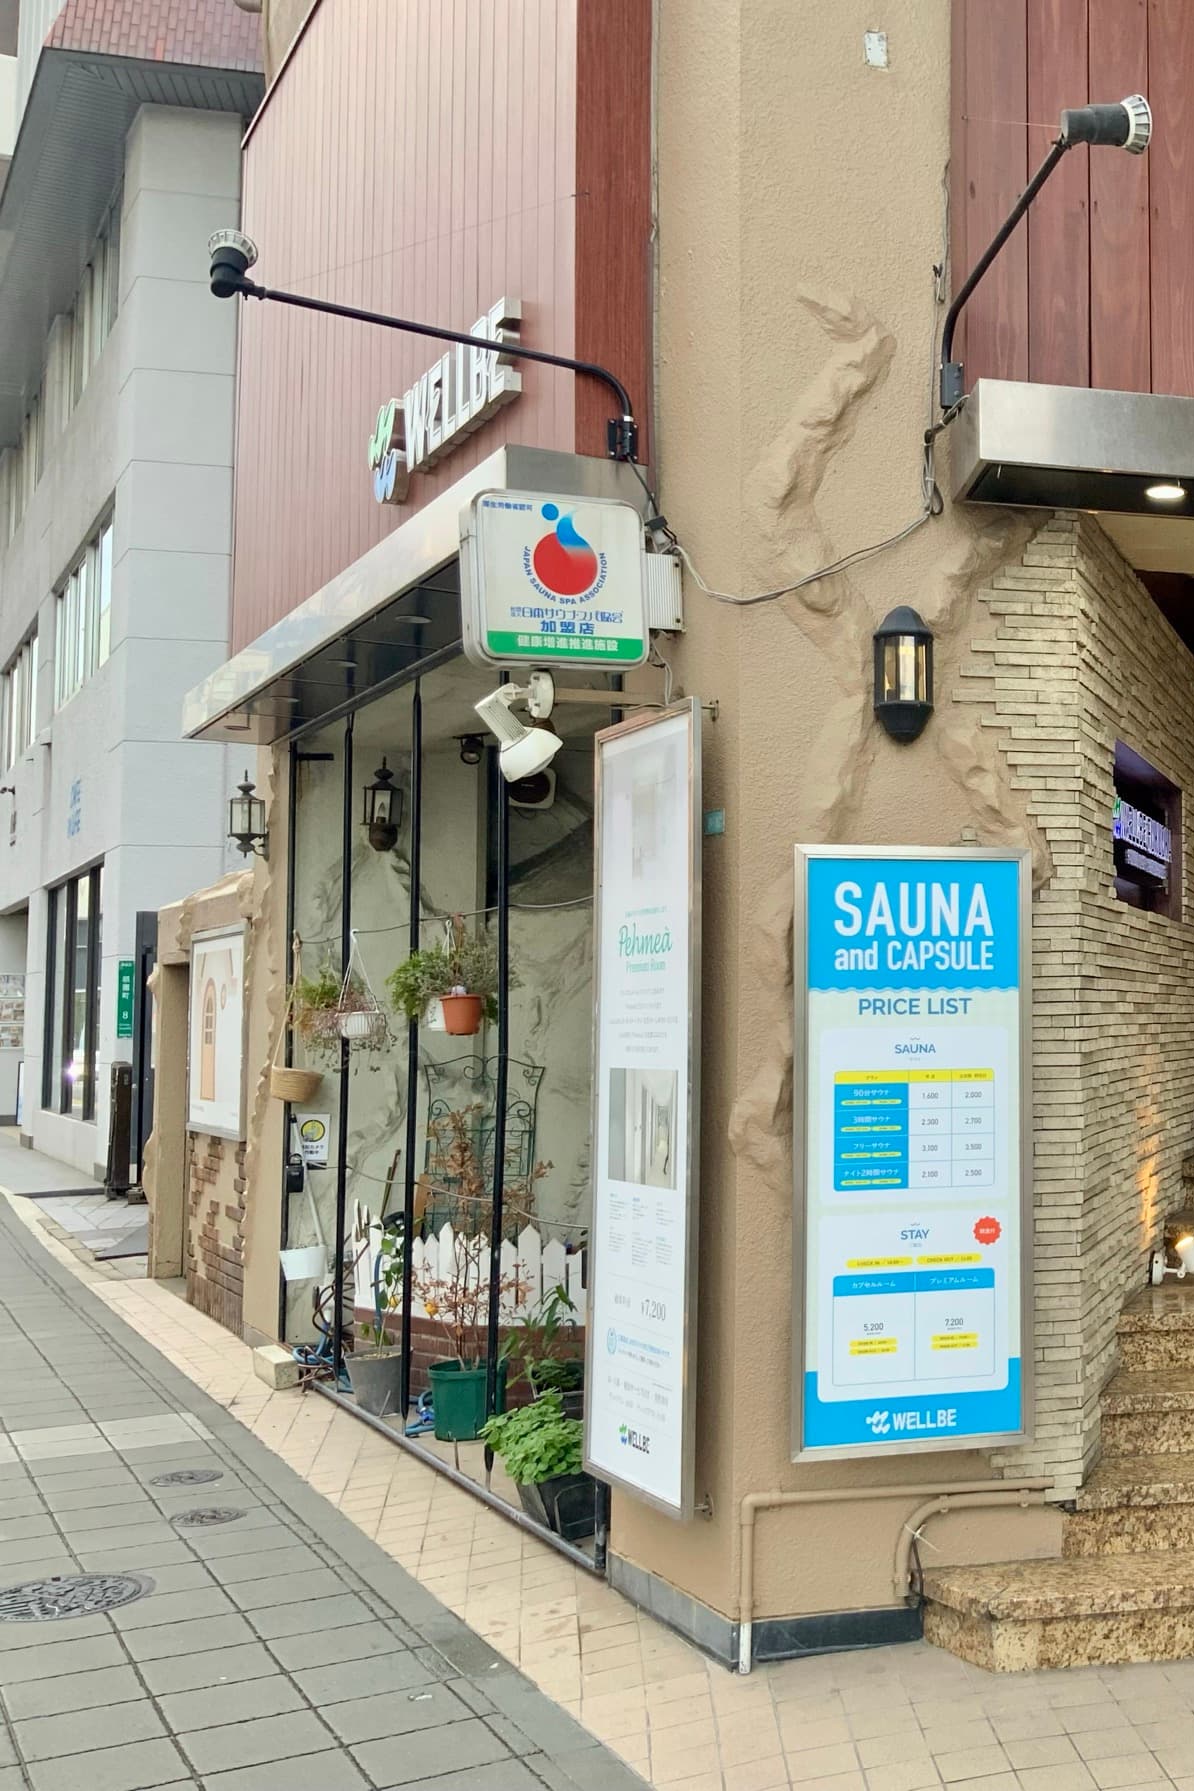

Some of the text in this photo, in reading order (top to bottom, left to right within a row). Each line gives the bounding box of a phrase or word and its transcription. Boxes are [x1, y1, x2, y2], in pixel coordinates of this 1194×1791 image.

[403, 296, 521, 473] WELLBE
[523, 545, 608, 605] JAPAN SAUNA SPA ASSOCIATION
[540, 620, 595, 635] 加盟店
[834, 881, 994, 937] SAUNA
[834, 940, 994, 971] and CAPSULE
[858, 998, 972, 1016] PRICE LIST
[894, 1043, 936, 1055] SAUNA
[900, 1229, 930, 1241] STAY
[893, 1408, 957, 1430] WELLBE
